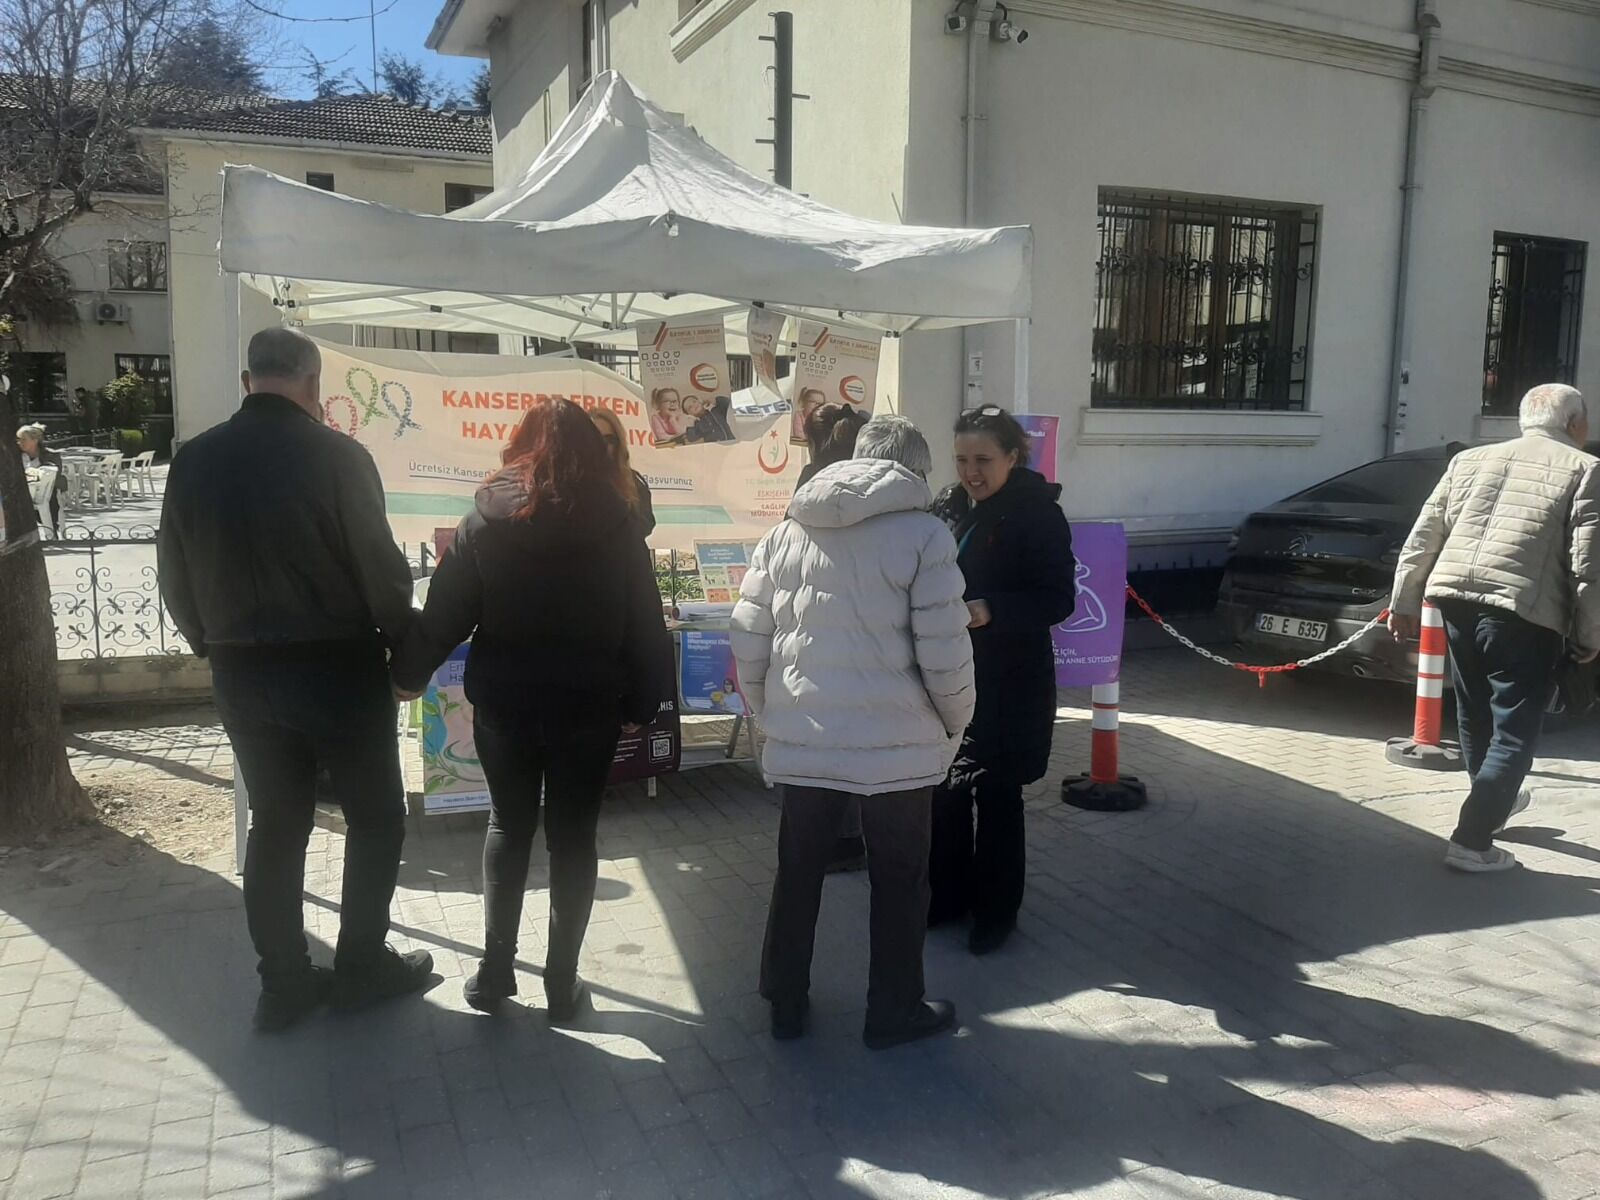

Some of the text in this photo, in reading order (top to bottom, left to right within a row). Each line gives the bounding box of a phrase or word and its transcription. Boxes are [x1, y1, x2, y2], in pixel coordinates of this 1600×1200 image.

[442, 390, 640, 417] KANSER ERKEN
[409, 459, 451, 475] Ücretsiz
[751, 509, 785, 517] MÜDÜRLÜ
[1261, 615, 1327, 640] 26 E 6357
